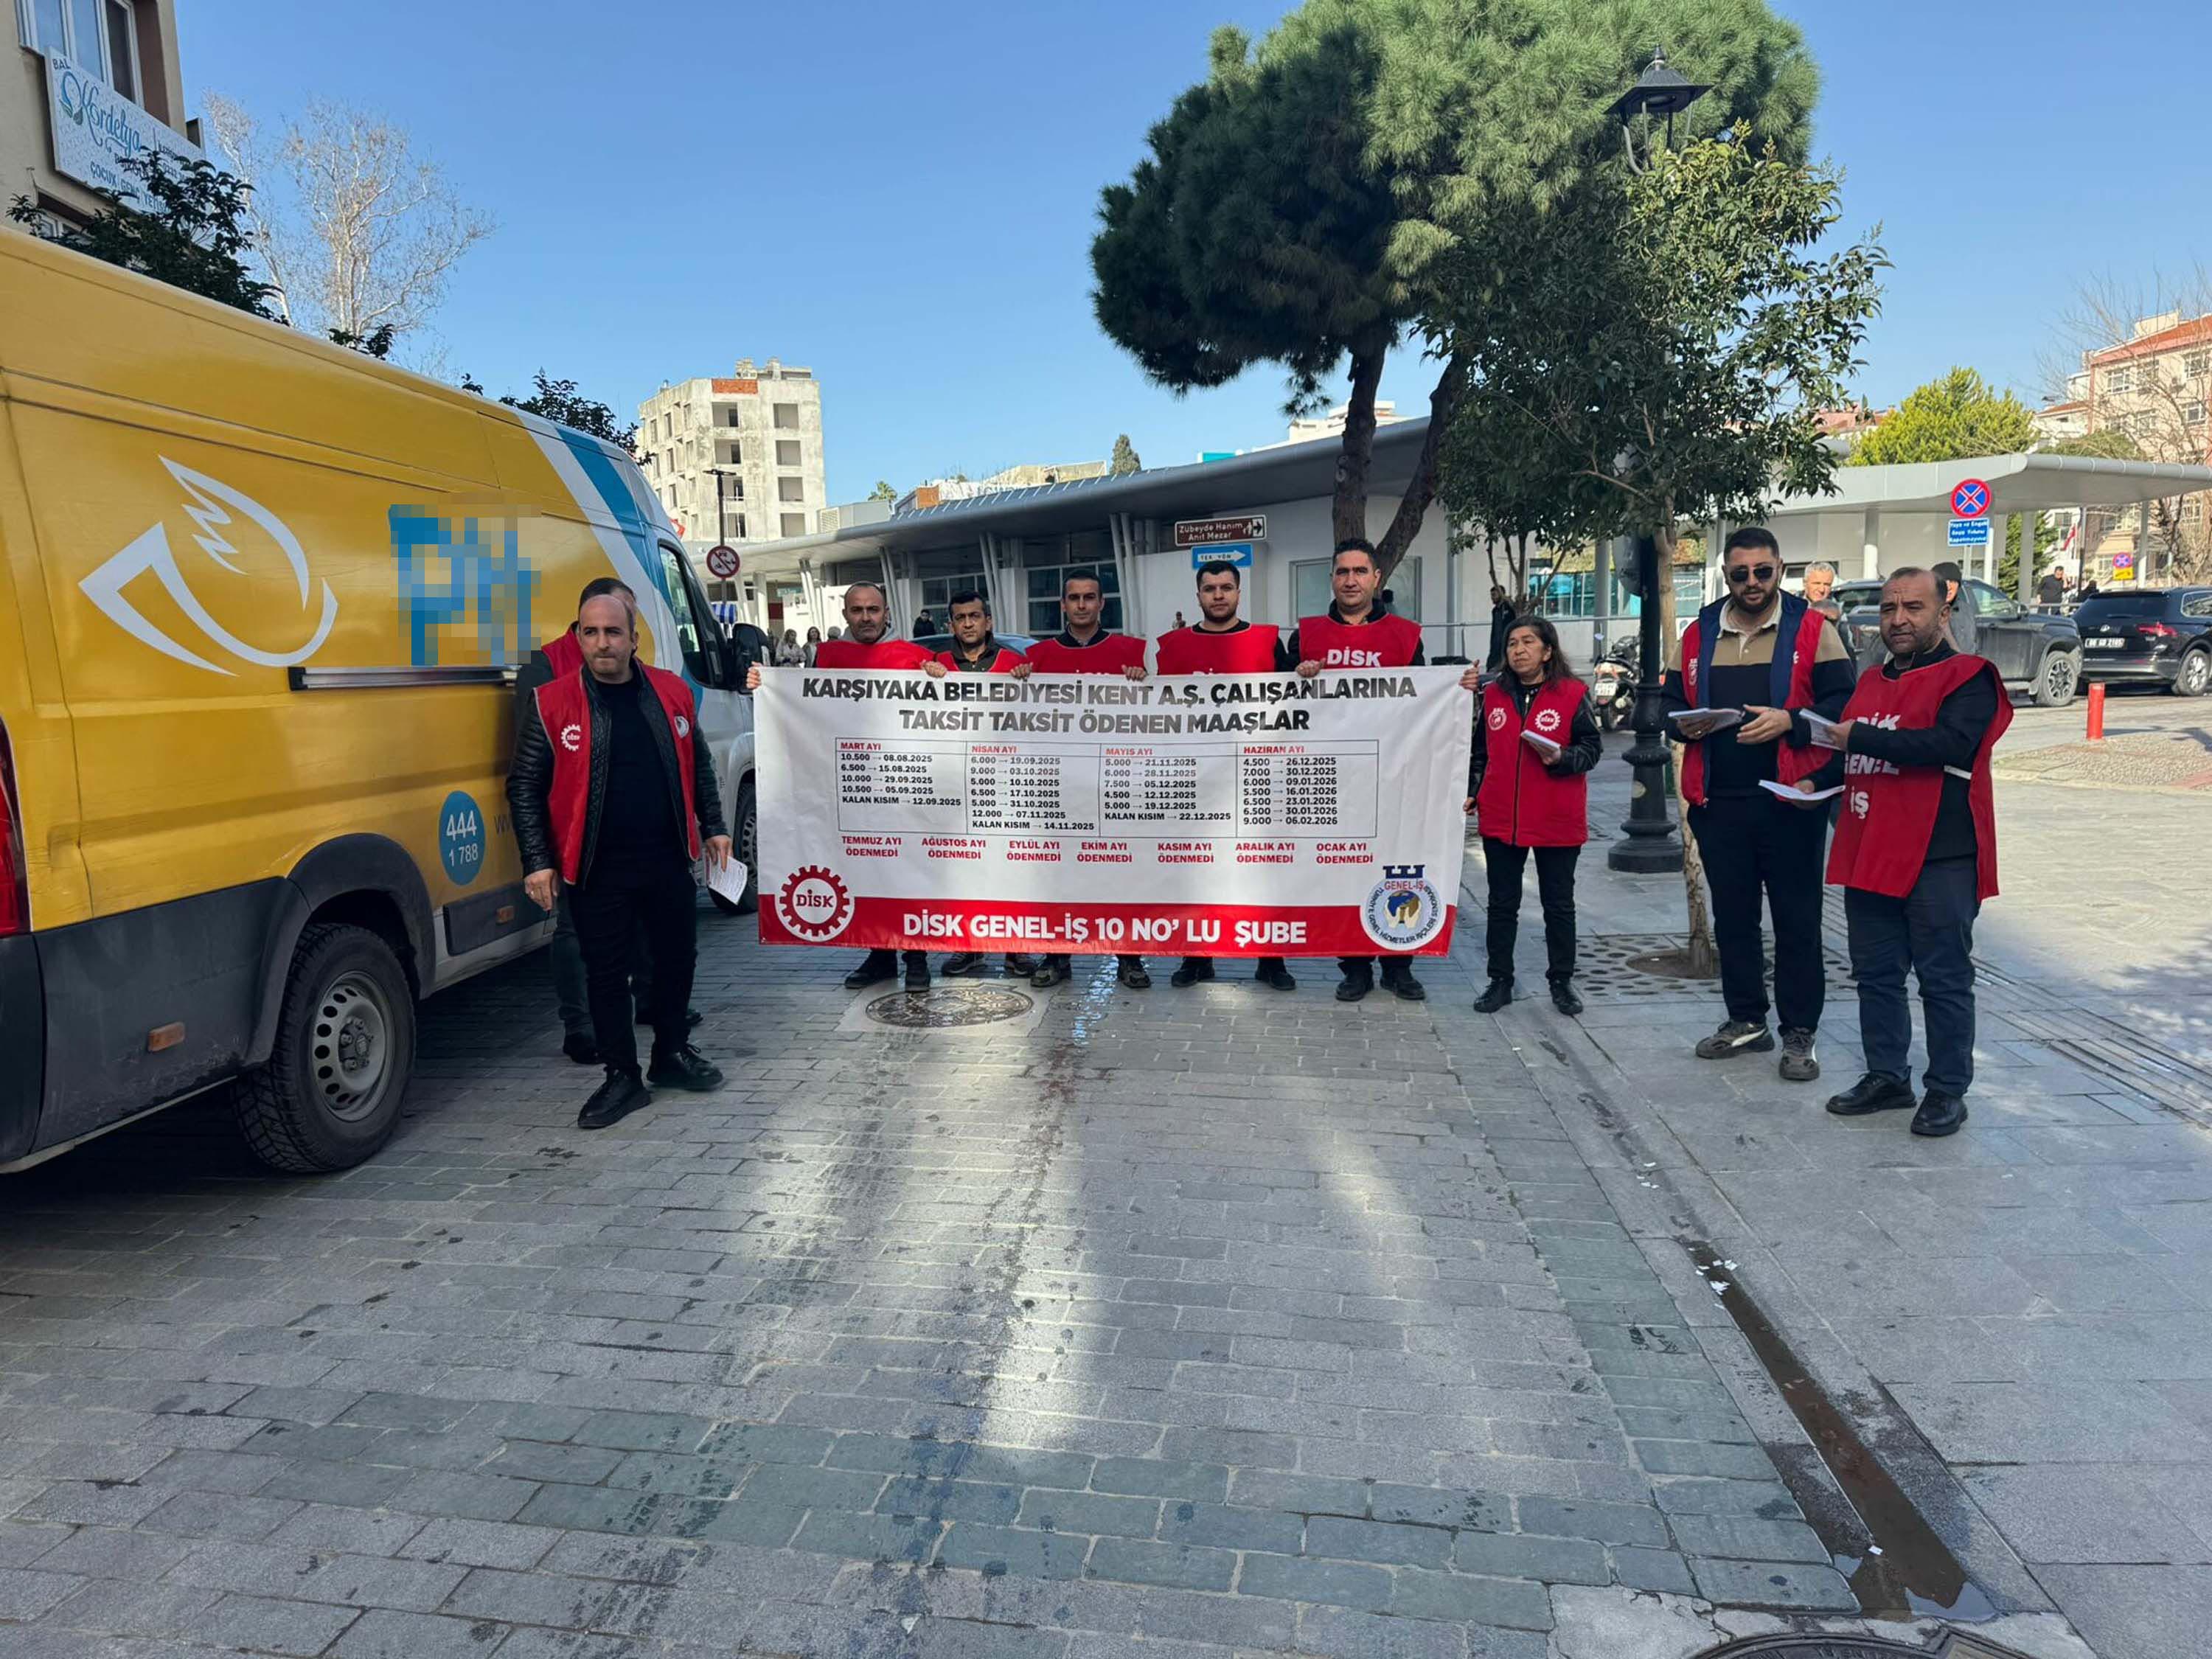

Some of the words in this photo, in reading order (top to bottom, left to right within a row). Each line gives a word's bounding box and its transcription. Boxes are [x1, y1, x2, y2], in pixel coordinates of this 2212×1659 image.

[52, 58, 71, 69] BAL
[1180, 525, 1214, 533] Zübeyde
[1328, 648, 1382, 667] DİSK
[802, 678, 939, 702] KARŞIYAKA
[944, 680, 1083, 704] BELEDİYESİ
[1088, 684, 1152, 705] KENT
[1158, 682, 1205, 708] A.Ş.
[1210, 677, 1417, 708] ÇALIŞANLARINA
[899, 708, 983, 731] TAKSİT
[989, 709, 1075, 733] TAKSİT
[1079, 709, 1182, 734] ÖDENEN
[1187, 709, 1310, 734] MAAŞLAR
[972, 745, 1000, 753] NİSAN
[1244, 745, 1286, 754] HAZİRAN
[1243, 758, 1270, 766] 4.500
[1286, 757, 1336, 765] 26.12.2025
[1243, 778, 1270, 786] 6.000
[1010, 800, 1060, 808] 31.10.2025
[1851, 786, 1869, 819] İŞ
[1286, 807, 1338, 815] 30.01.2026
[447, 810, 477, 841] 444
[842, 836, 883, 845] TEMMUZ
[885, 837, 902, 846] AYI
[922, 835, 967, 847] AĞUSTOS
[970, 839, 986, 847] AYI
[1009, 839, 1040, 849] EYLÜL
[1043, 841, 1060, 849] AYI
[1081, 840, 1107, 850] EKİM
[1110, 841, 1127, 850] AYI
[1158, 843, 1192, 851] KASIM
[1194, 843, 1212, 851] AYI
[1236, 843, 1275, 851] ARALIK
[1277, 843, 1295, 851] AYI
[1316, 844, 1347, 852] OCAK
[1349, 843, 1367, 851] AYI
[449, 849, 454, 866] 1
[459, 843, 478, 865] 788
[846, 848, 898, 857] ÖDENMEDİ
[928, 849, 981, 859] ÖDENMEDİ
[1007, 851, 1061, 862] ÖDENMEDİ
[1077, 852, 1133, 863] ÖDENMEDİ
[1158, 853, 1214, 863] ÖDENMEDİ
[1237, 853, 1293, 863] ÖDENMEDİ
[1316, 853, 1374, 863] ÖDENMEDİ
[1384, 879, 1424, 891] GENEL-İŞ
[796, 888, 834, 908] DİSK
[903, 908, 964, 938] DİSK
[970, 912, 1089, 944] GENEL-İŞ
[1095, 917, 1124, 940] 10
[1186, 920, 1220, 943] LU
[1234, 921, 1307, 947] ŞUBE
